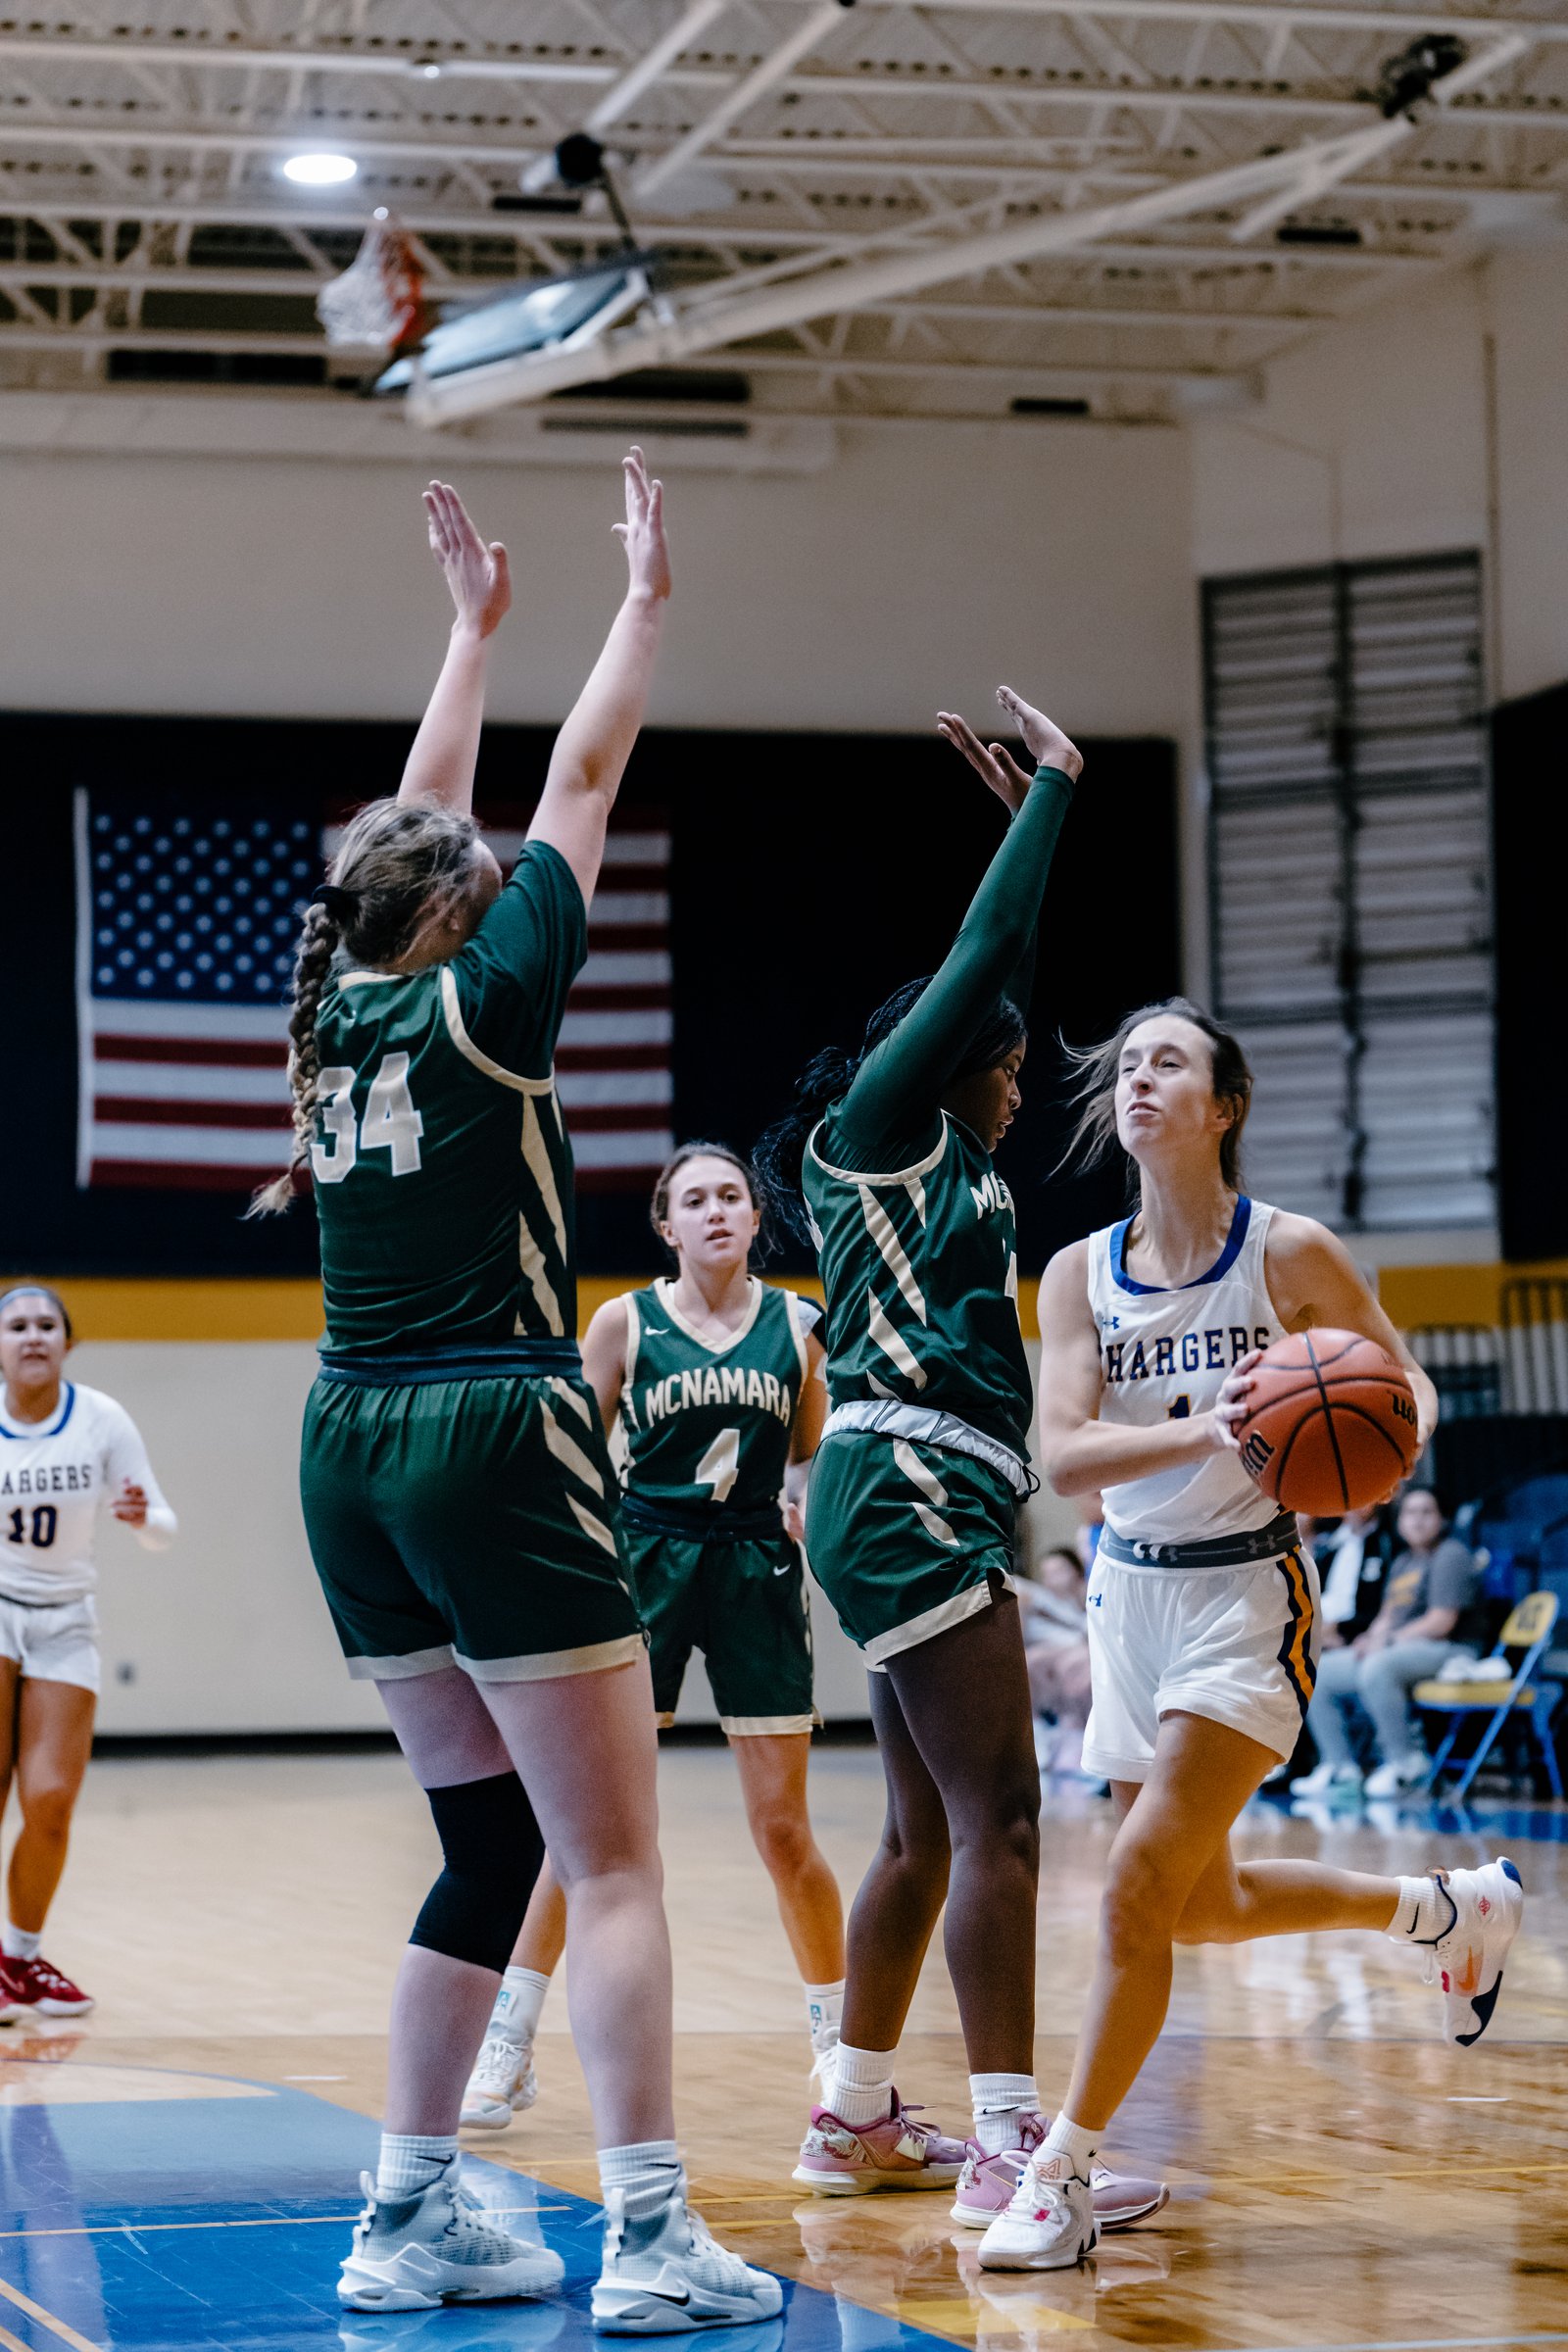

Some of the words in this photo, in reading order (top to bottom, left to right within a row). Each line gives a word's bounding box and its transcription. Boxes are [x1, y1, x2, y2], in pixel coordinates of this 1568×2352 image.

[310, 1051, 424, 1184] 34
[645, 1366, 791, 1428] MCNAMARA
[1, 1464, 93, 1495] ARGERS
[695, 1428, 740, 1502] 4
[8, 1504, 58, 1548] 10
